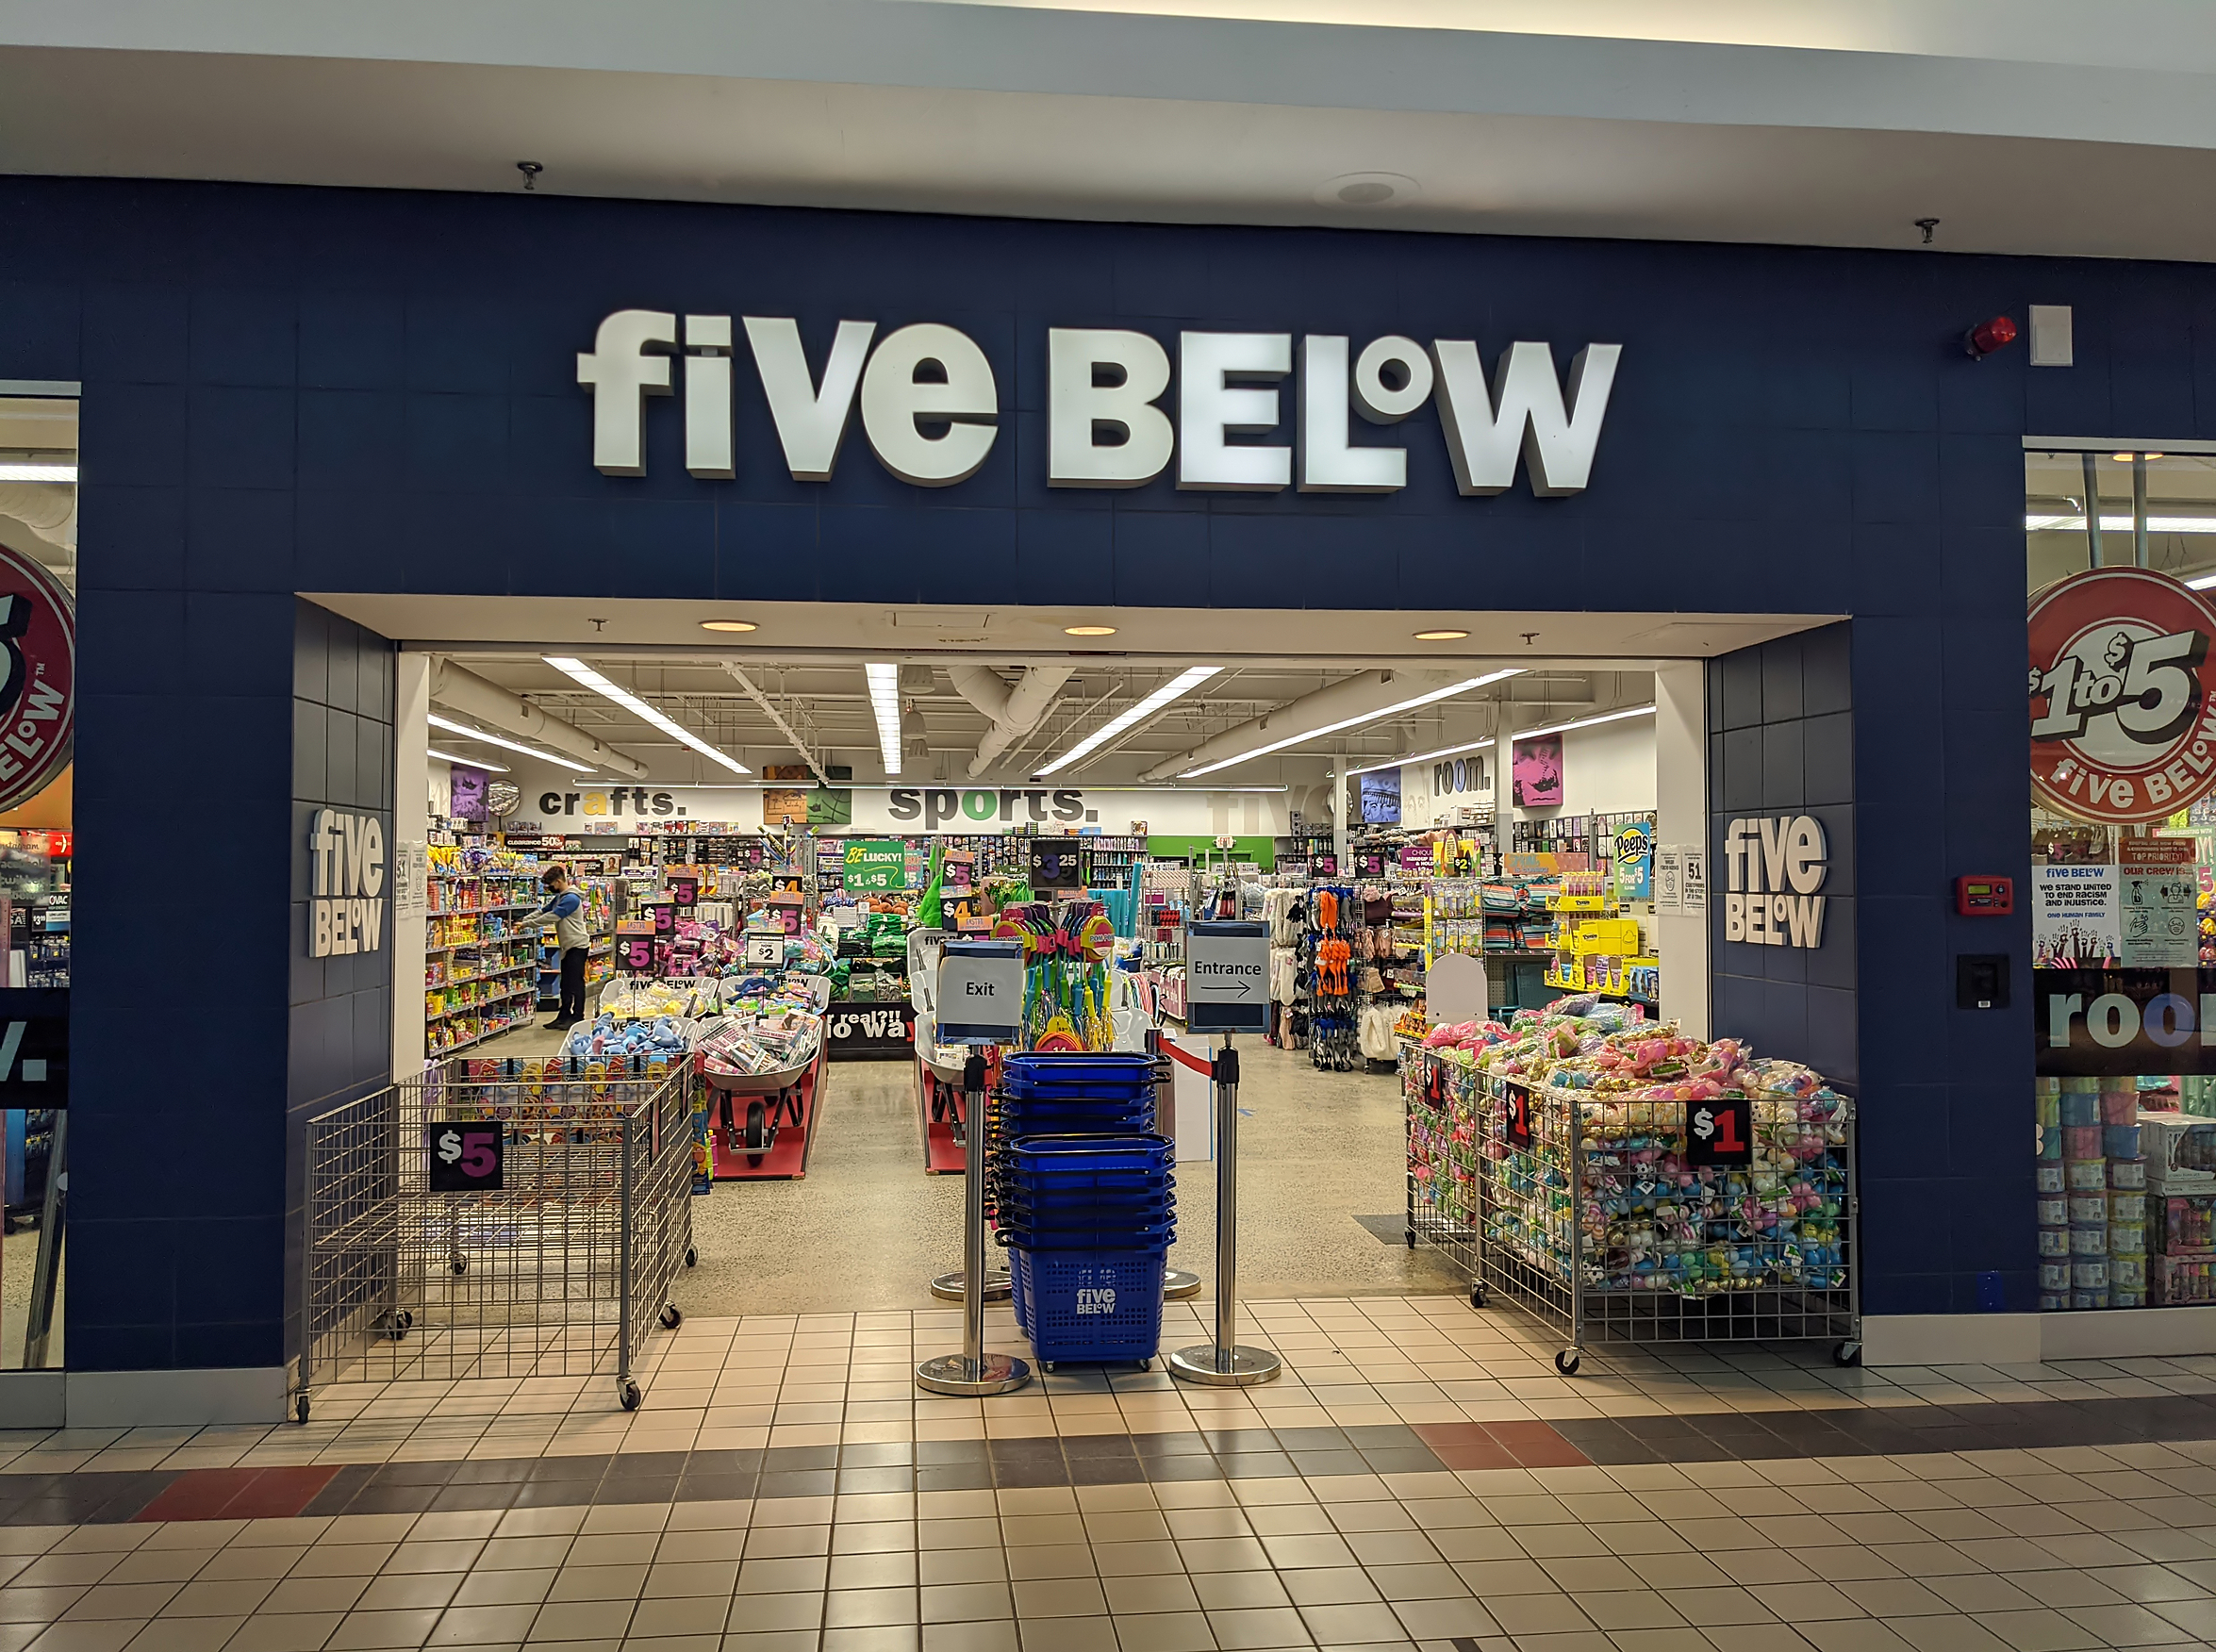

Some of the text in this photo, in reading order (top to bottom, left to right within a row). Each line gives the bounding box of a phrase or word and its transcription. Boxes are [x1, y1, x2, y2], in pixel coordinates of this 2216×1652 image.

[576, 309, 1623, 496] five BELOW
[2073, 671, 2123, 708] to
[2104, 630, 2197, 733] $5
[1434, 755, 1491, 797] room.
[2050, 757, 2135, 809] five
[539, 786, 686, 816] crafts.
[888, 789, 1099, 831] sports.
[310, 809, 385, 898] five
[744, 849, 762, 864] $5
[846, 847, 867, 864] BE
[863, 852, 902, 862] LUCKY!
[1614, 835, 1648, 859] Peeps
[1725, 815, 1827, 895] five
[945, 864, 970, 884] $5
[1315, 856, 1335, 873] $5
[1359, 855, 1381, 874] $5
[1455, 859, 1468, 869] $2
[1688, 863, 1702, 880] 51
[2046, 868, 2104, 877] five BELOW
[774, 879, 798, 892] $4
[848, 873, 865, 886] $1
[870, 873, 887, 886] $5
[1619, 867, 1644, 884] 5 FOR $5
[670, 884, 694, 903] $5
[644, 907, 672, 930] $5
[943, 900, 971, 918] $4
[309, 898, 384, 958] BELOW
[771, 909, 799, 932] $5
[1726, 893, 1827, 949] BELOW
[620, 941, 650, 967] $5
[758, 949, 773, 961] $2
[1194, 961, 1262, 976] Entrance
[966, 982, 995, 997] Exit
[840, 1010, 901, 1024] real?!!
[1425, 1062, 1441, 1099] $1
[1509, 1090, 1530, 1136] $1
[1694, 1107, 1745, 1152] $1
[438, 1130, 497, 1178] $5
[1077, 1288, 1116, 1304] five
[1077, 1304, 1116, 1314] BELOW
